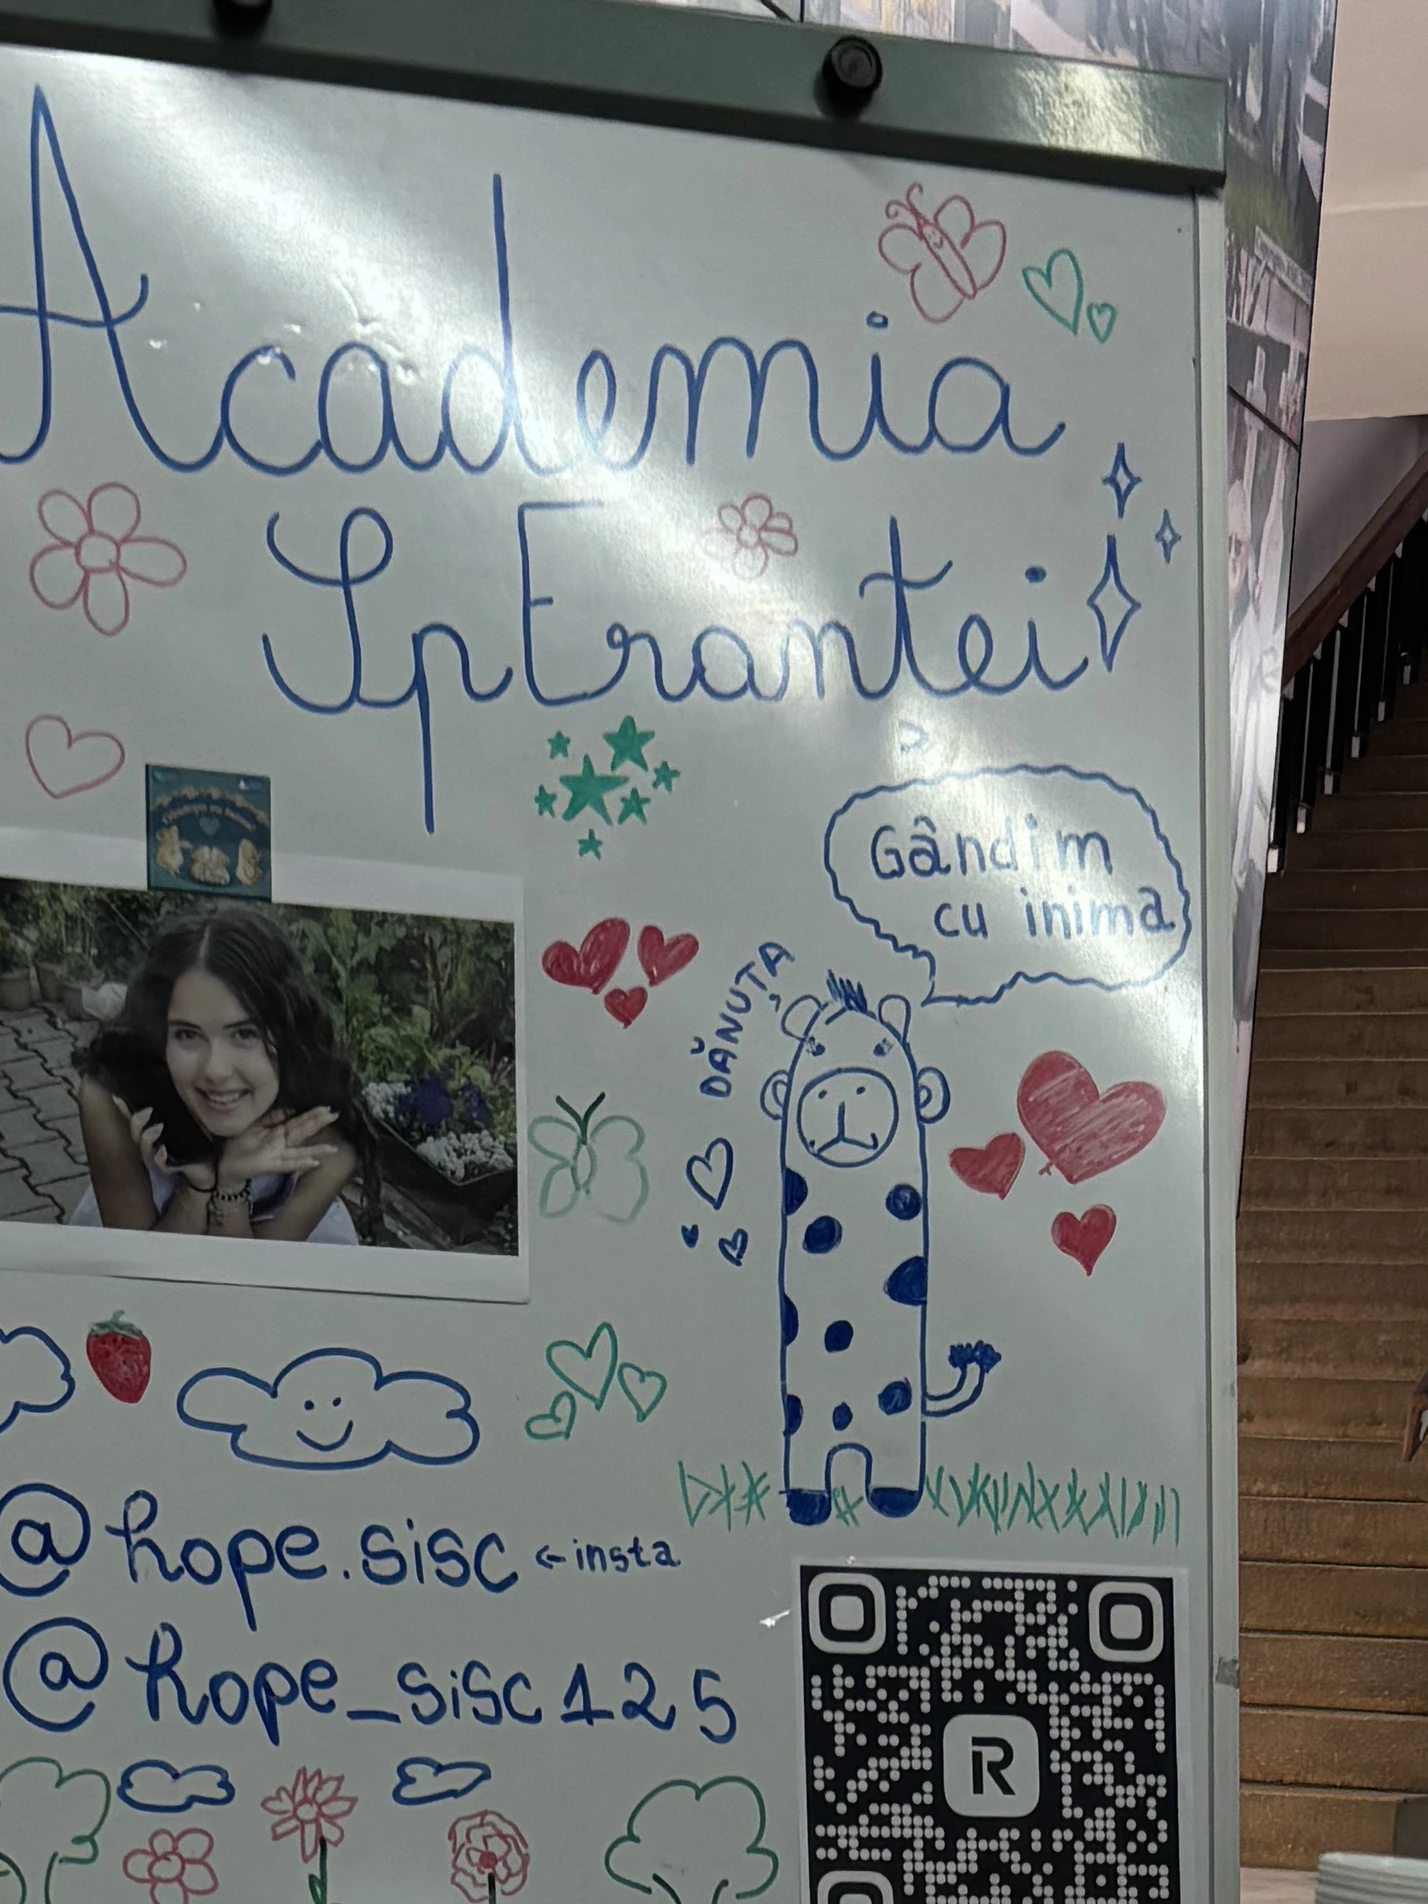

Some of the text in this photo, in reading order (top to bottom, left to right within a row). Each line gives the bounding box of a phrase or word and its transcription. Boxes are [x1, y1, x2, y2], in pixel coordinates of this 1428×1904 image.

[869, 813, 1113, 880] Gândim
[933, 885, 1176, 940] cu inima
[570, 1536, 682, 1572] insta
